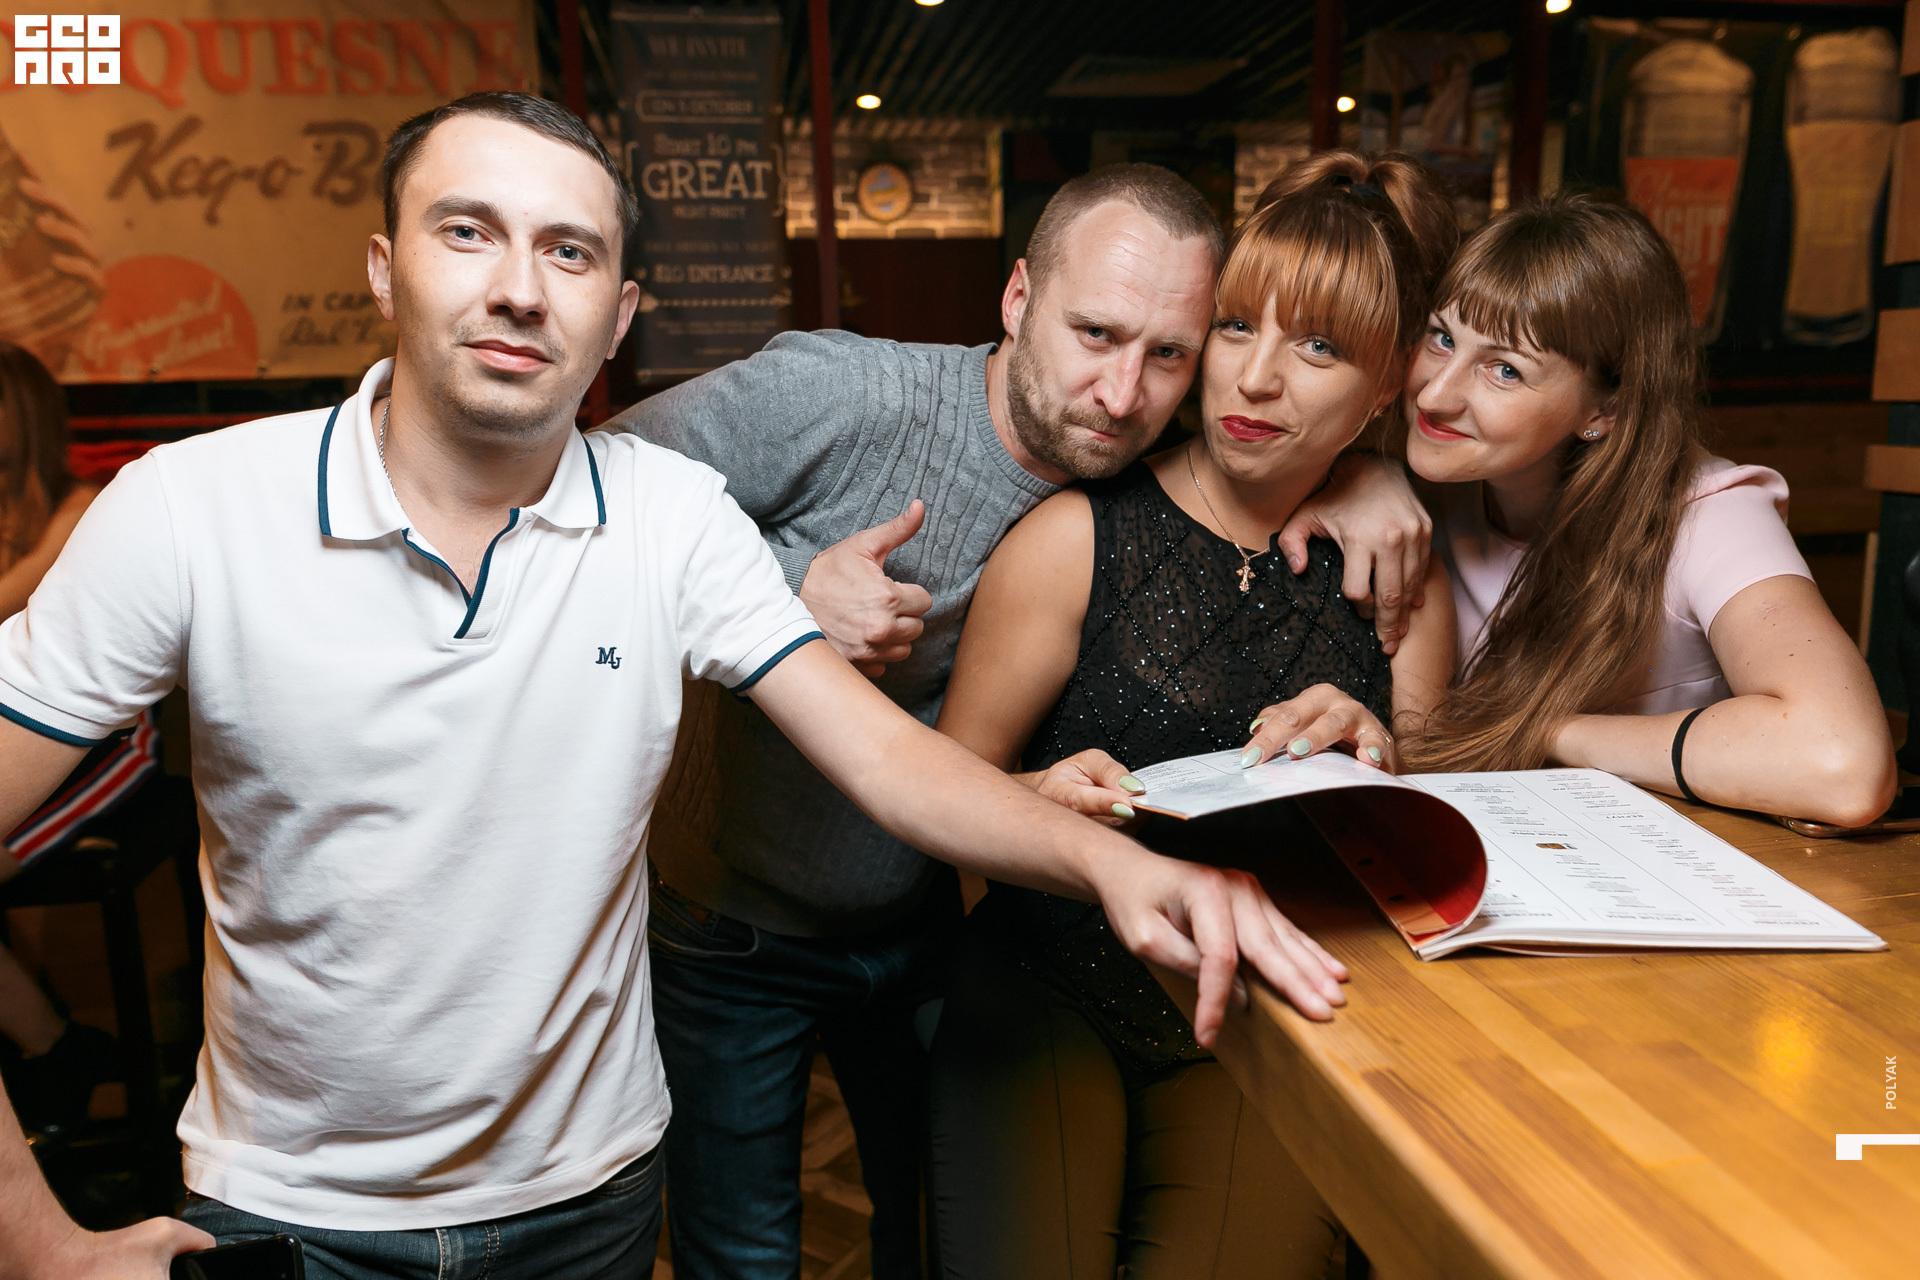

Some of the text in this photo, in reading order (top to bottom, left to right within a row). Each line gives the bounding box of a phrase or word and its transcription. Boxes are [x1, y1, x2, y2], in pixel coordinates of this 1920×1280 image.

[706, 131, 733, 157] 10
[641, 158, 774, 201] GREAT
[686, 263, 777, 283] ENTRANCE
